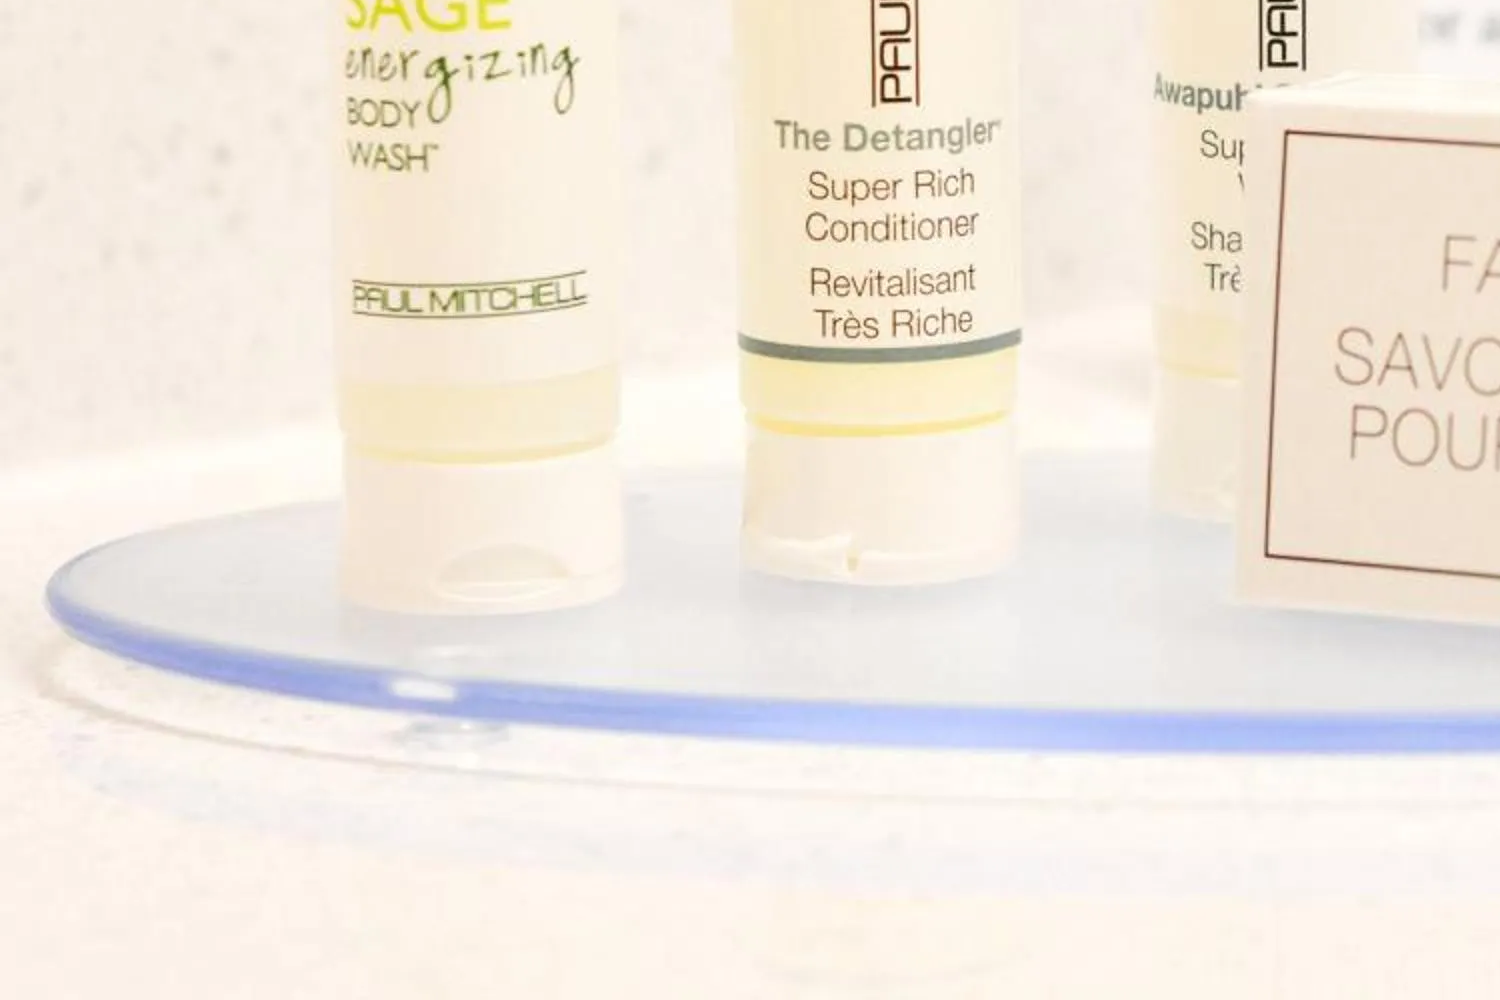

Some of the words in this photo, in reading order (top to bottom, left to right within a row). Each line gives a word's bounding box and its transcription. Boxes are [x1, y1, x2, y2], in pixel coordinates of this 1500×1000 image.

[343, 41, 581, 124] energizing
[1154, 71, 1262, 114] Awapuh
[347, 96, 421, 130] BODY
[773, 119, 832, 152] The
[807, 169, 904, 207] Super
[914, 167, 976, 199] Rich
[804, 211, 980, 243] Conditioner
[1190, 220, 1243, 253] Sha
[353, 285, 424, 313] PAUL
[429, 278, 588, 313] MITCHELL
[810, 264, 977, 298] Revitalisant
[812, 309, 880, 340] Très
[891, 305, 974, 338] Riche
